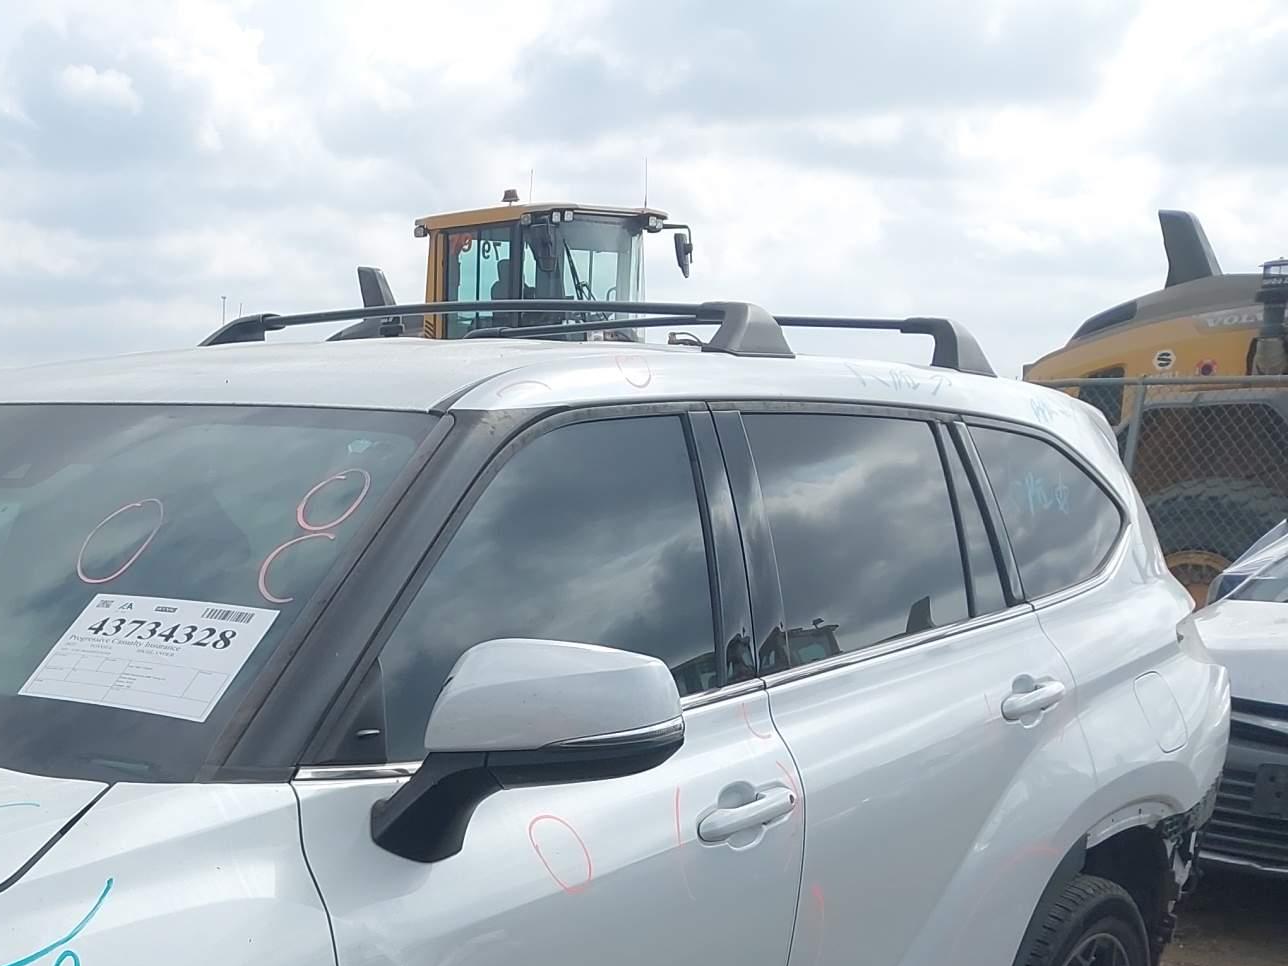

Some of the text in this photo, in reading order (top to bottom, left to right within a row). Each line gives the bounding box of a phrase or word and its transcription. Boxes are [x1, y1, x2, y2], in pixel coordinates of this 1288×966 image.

[68, 634, 111, 645] Progressive
[143, 641, 182, 652] Insurance
[87, 616, 238, 650] 43734328
